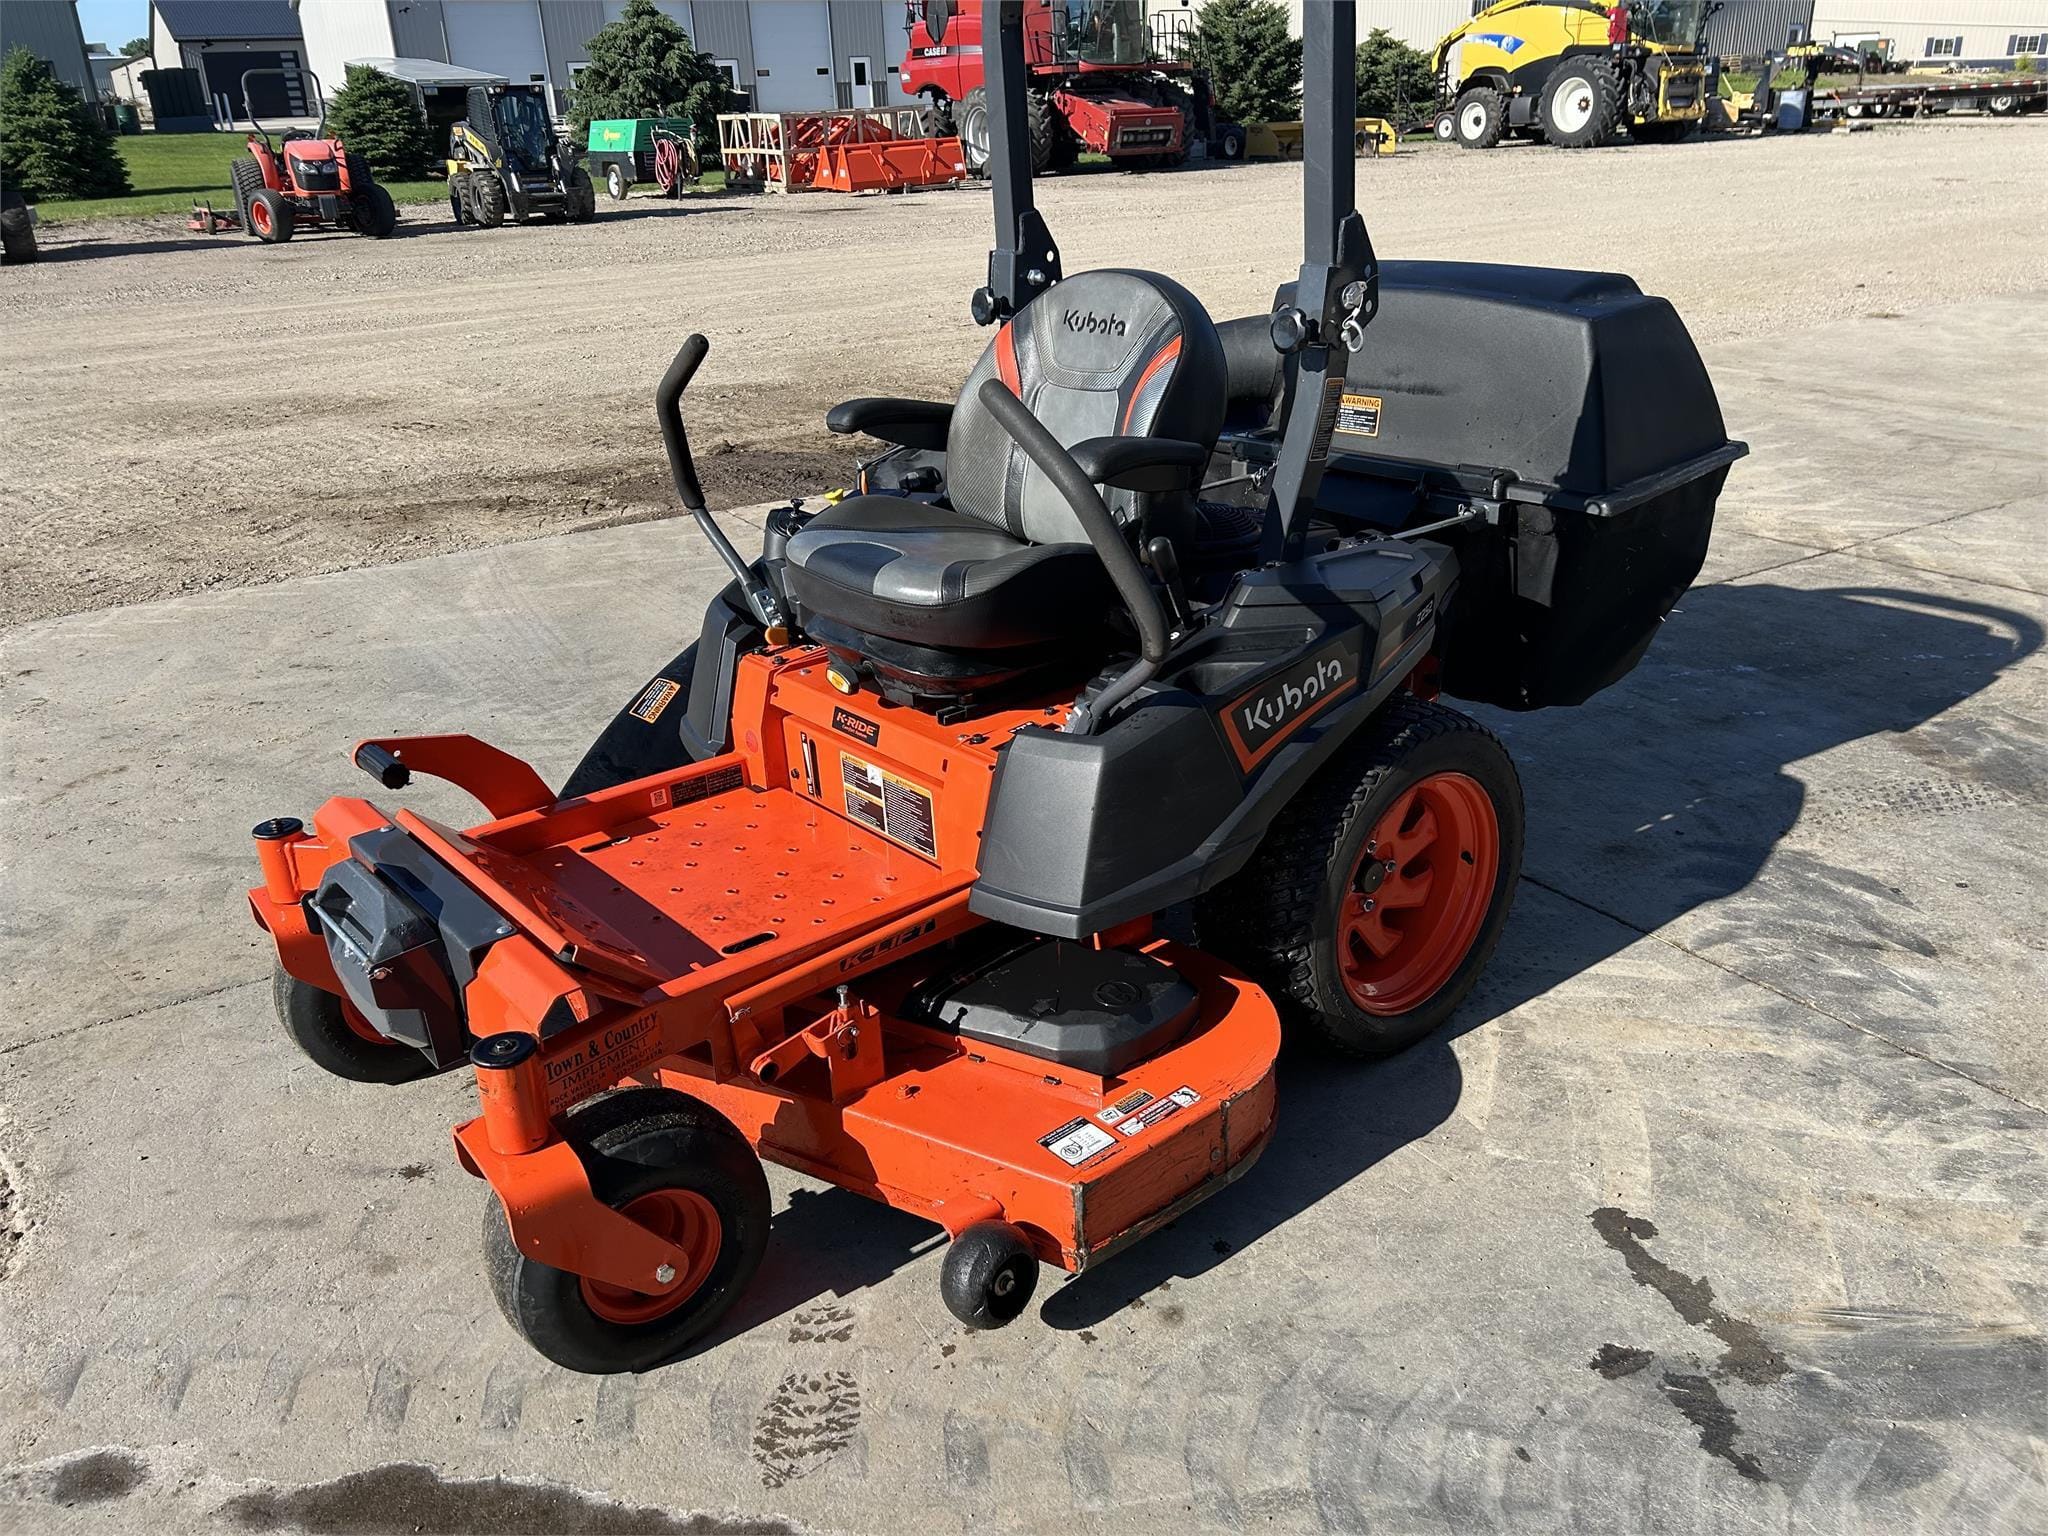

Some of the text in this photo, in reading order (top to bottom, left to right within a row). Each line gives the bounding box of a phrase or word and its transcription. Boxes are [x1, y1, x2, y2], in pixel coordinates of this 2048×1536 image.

[924, 47, 940, 56] CASE
[1063, 309, 1126, 336] Kubota
[1344, 395, 1380, 408] WARNING
[1244, 659, 1343, 731] Kubota
[843, 919, 933, 970] K-LIFT
[544, 1010, 658, 1081] Town & Country
[562, 1035, 648, 1090] IMPLEMENT
[550, 1092, 568, 1105] ROCK
